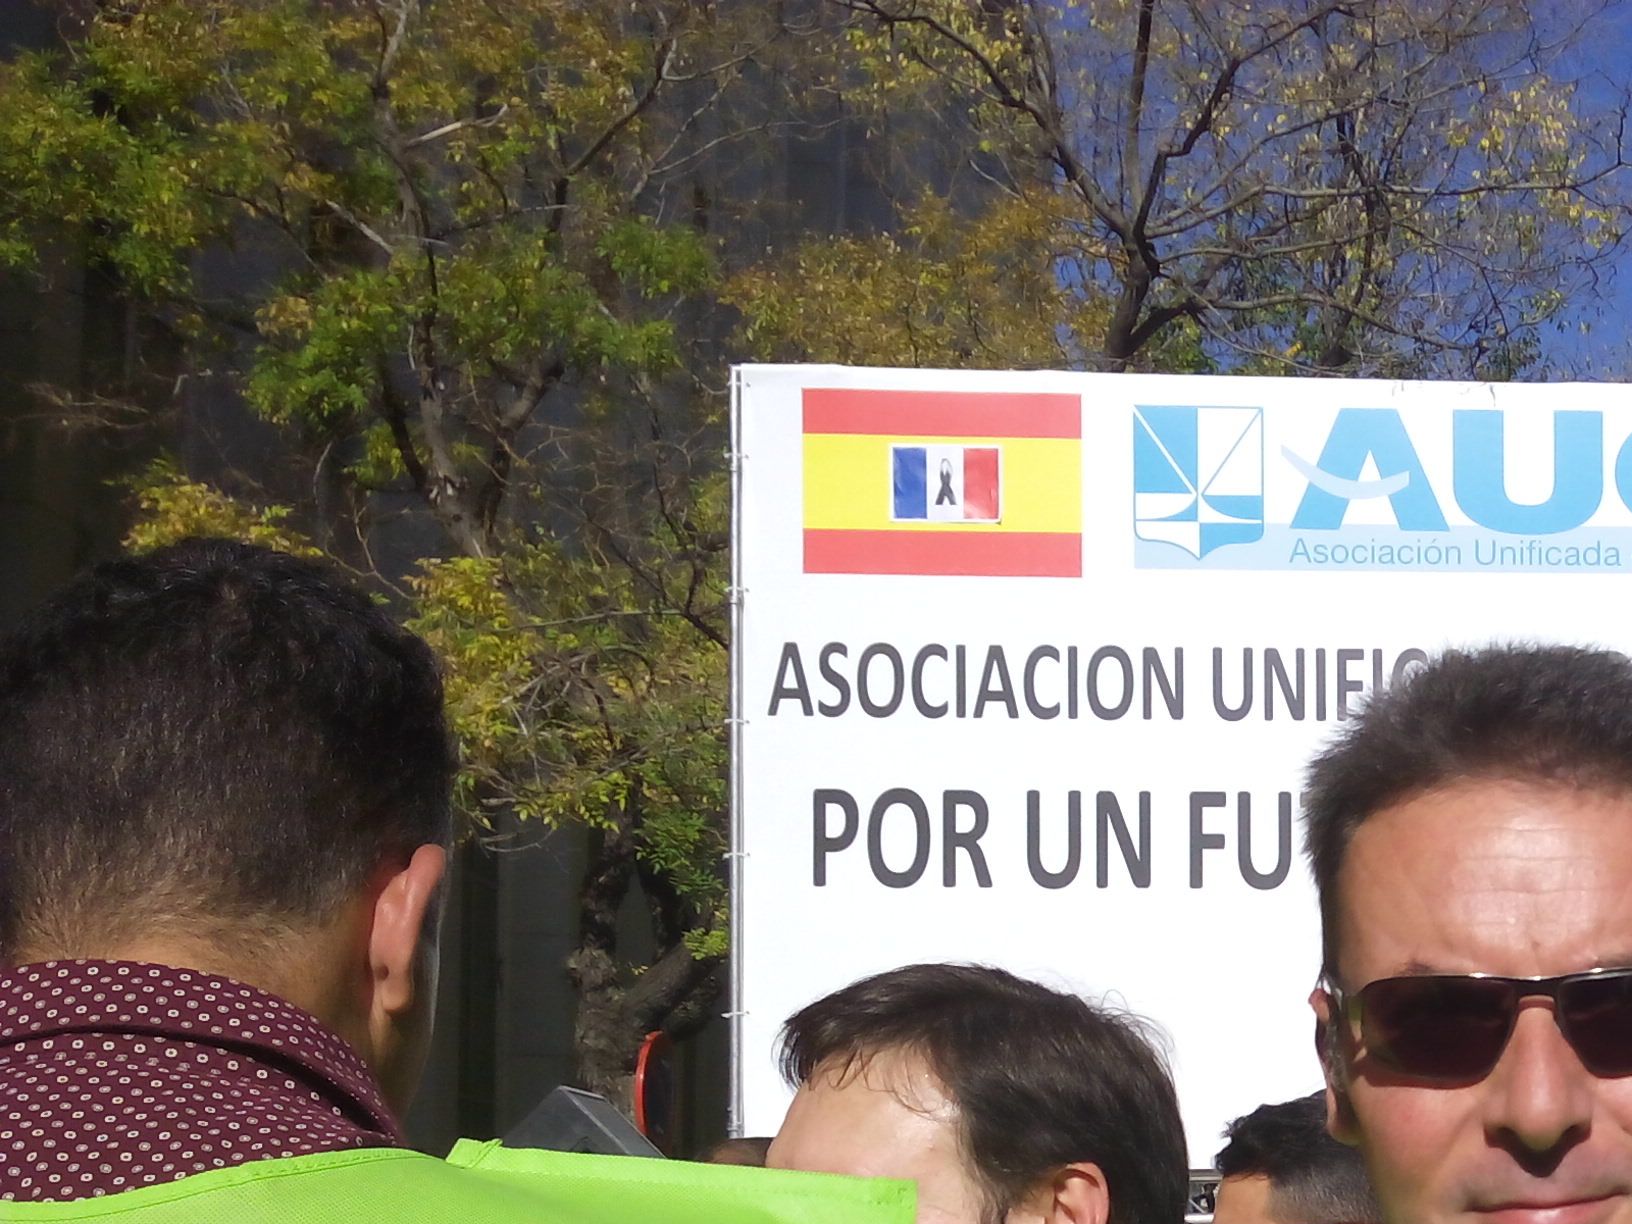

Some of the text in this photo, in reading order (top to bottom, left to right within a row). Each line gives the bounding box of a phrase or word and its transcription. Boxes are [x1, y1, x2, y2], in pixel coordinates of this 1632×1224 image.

[1288, 537, 1462, 566] Asociación
[1474, 539, 1622, 567] Unificada
[767, 641, 1184, 721] ASOCIACION
[1212, 646, 1458, 722] UNIFIC
[812, 787, 993, 889] POR
[1026, 789, 1152, 890] UN
